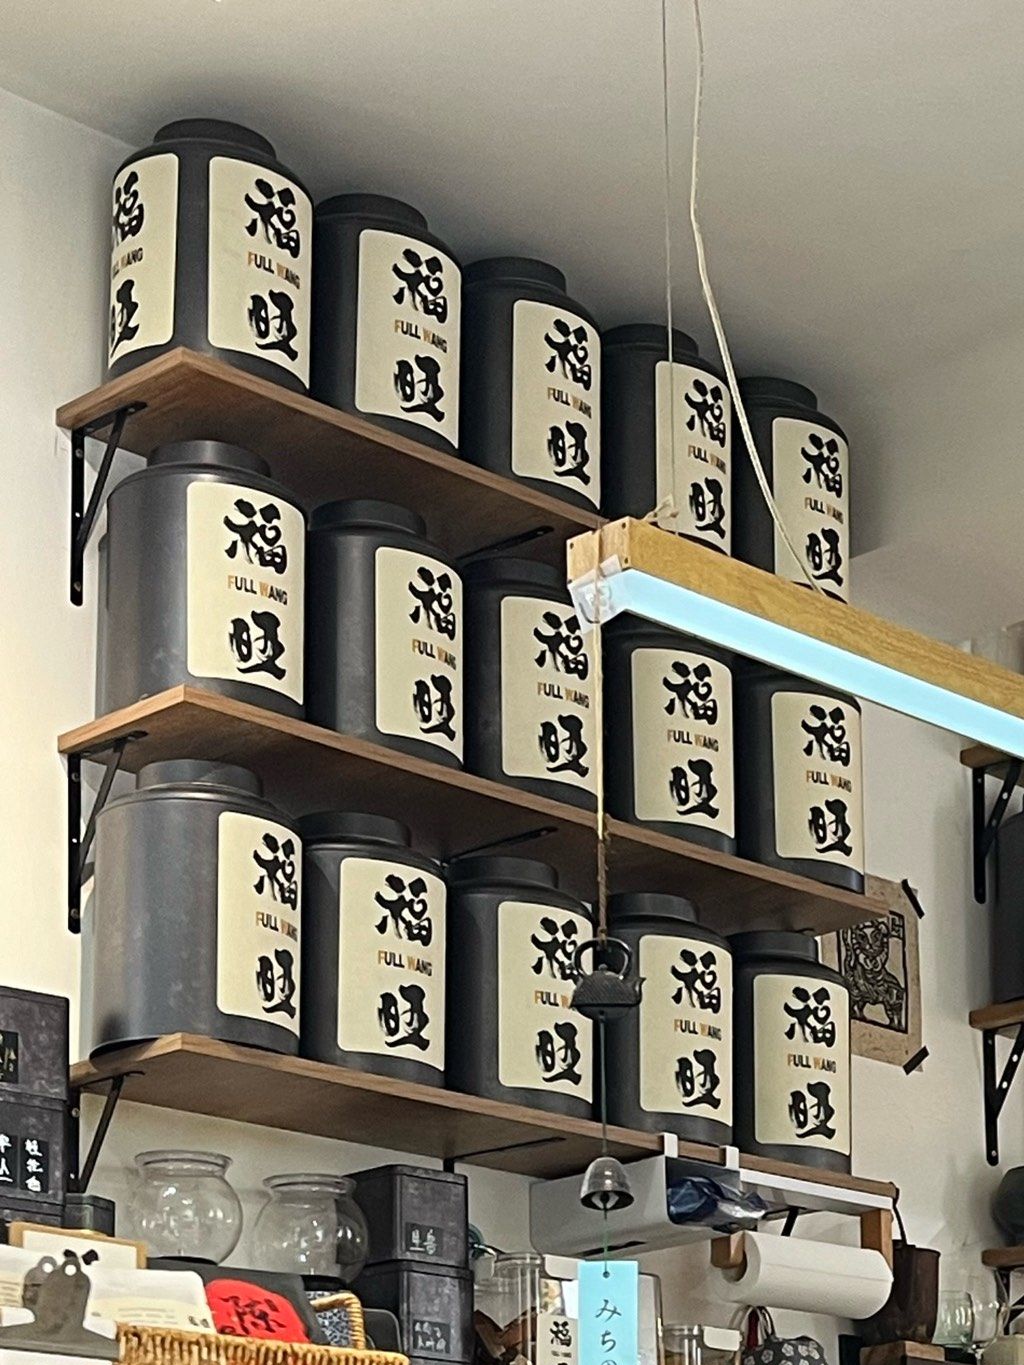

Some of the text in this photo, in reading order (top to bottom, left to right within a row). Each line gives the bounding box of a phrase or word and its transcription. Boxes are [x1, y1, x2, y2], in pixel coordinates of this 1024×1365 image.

[245, 177, 301, 259] 福
[248, 251, 300, 290] FULL WANG
[392, 247, 448, 325] 福
[246, 289, 298, 362] 旺
[393, 319, 447, 354] FULL WANG
[544, 318, 593, 391] 福
[393, 355, 445, 423] 旺
[547, 387, 571, 406] FULL
[685, 379, 725, 448] 福
[547, 421, 590, 486] 旺
[688, 444, 709, 463] FULL
[801, 432, 843, 499] 福
[224, 498, 288, 574] 福
[689, 477, 726, 540] 旺
[804, 497, 825, 515] FULL
[805, 528, 843, 588] 旺
[228, 575, 288, 606] FULL WANG
[409, 566, 457, 641] 福
[229, 611, 286, 681] 旺
[412, 638, 436, 659] FULL
[534, 610, 589, 680] 福
[412, 674, 456, 742] 旺
[537, 681, 589, 709] FULL WANG
[663, 660, 718, 725] 福
[538, 714, 589, 778] 旺
[665, 728, 719, 752] FULL WANG
[801, 704, 851, 767] 福
[669, 759, 719, 819] 旺
[806, 770, 852, 793] FULL WANG
[808, 799, 852, 856] 旺
[253, 832, 297, 911] 福
[256, 911, 279, 932] FULL
[374, 873, 433, 946] 福
[255, 949, 296, 1019] 旺
[378, 950, 432, 977] FULL WANG
[671, 949, 721, 1014] 福
[378, 984, 430, 1051] 旺
[534, 990, 560, 1007] FULL
[674, 1019, 722, 1041] FULL WANG
[784, 987, 835, 1047] 福
[535, 1022, 582, 1085] 旺
[675, 1049, 721, 1109] 旺
[787, 1053, 836, 1073] FULL WANG
[788, 1082, 836, 1139] 旺
